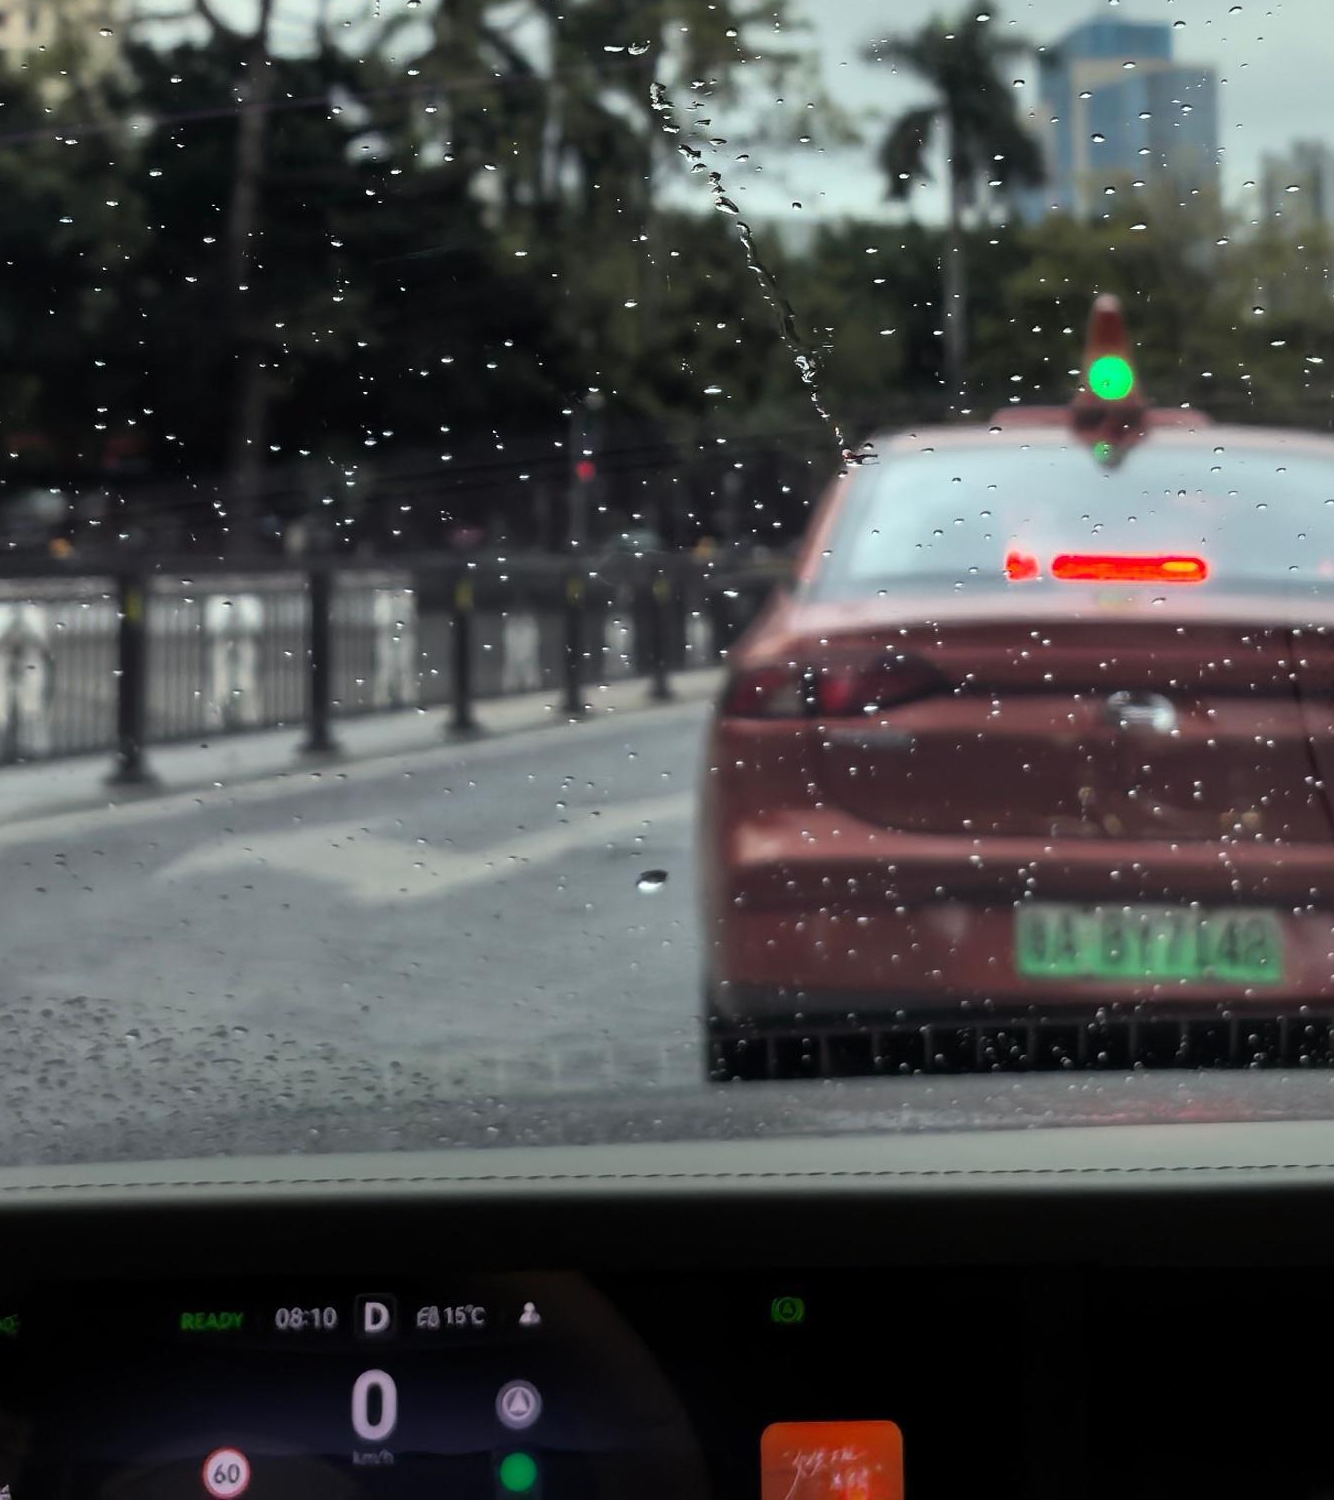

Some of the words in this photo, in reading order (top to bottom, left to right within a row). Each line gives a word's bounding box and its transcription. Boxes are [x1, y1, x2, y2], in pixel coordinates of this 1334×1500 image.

[181, 1312, 244, 1330] READY
[275, 1307, 338, 1328] 08:10
[364, 1301, 390, 1332] D
[352, 1369, 398, 1440] 0
[213, 1463, 240, 1484] 60
